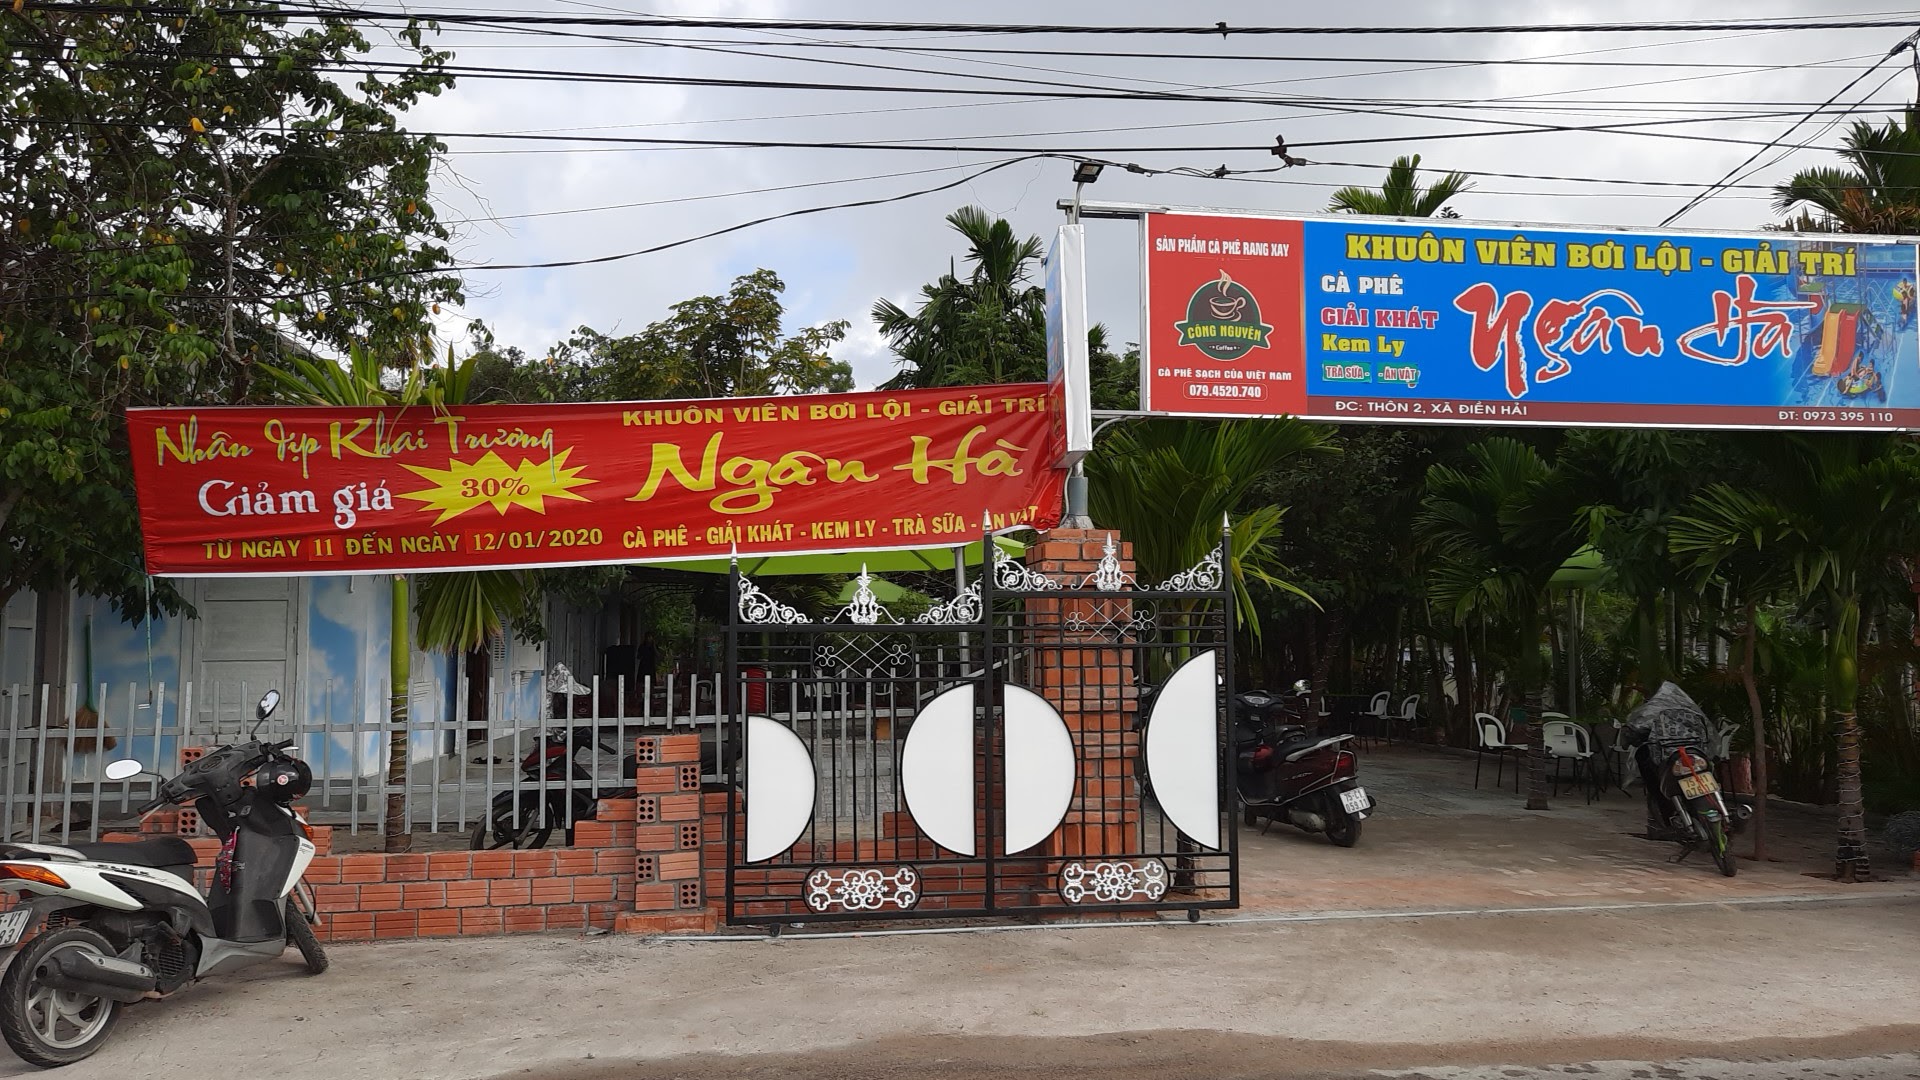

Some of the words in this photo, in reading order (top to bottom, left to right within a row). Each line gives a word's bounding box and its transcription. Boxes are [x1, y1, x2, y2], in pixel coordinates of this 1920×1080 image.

[1156, 235, 1176, 252] SẢN
[1208, 239, 1221, 254] CÀ
[1222, 239, 1241, 255] PHÊ
[1243, 241, 1269, 256] RANG
[1271, 243, 1290, 257] XAY
[1346, 231, 1466, 263] KHUÔN
[1474, 234, 1557, 267] VIÊN
[1567, 240, 1626, 270] BƠI
[1635, 241, 1691, 276] LỘI
[1722, 242, 1790, 275] GIẢI
[1798, 247, 1857, 276] TRÍ
[1321, 271, 1350, 293] CÀ
[1358, 274, 1404, 295] PHÊ
[1321, 302, 1369, 327] GIẢI
[1375, 306, 1439, 329] KHÁT
[1187, 324, 1217, 339] CÔNG
[1322, 333, 1370, 352] Kem
[1378, 335, 1405, 358] Ly
[1158, 366, 1171, 377] CÀ
[1173, 368, 1192, 378] PHÊ
[1195, 369, 1221, 380] SẠCH
[1224, 368, 1243, 379] CỦA
[1246, 370, 1266, 382] VIỆT
[1269, 372, 1292, 381] NAM
[1325, 365, 1344, 379] TRÀ
[1189, 384, 1262, 398] 079.4520.740
[623, 405, 724, 426] KHUÔN
[733, 402, 800, 422] VIÊN
[810, 401, 856, 420] BƠI
[867, 398, 911, 421] LỘI
[938, 394, 992, 416] GIẢI
[1001, 393, 1046, 413] TRÍ
[1335, 401, 1363, 412] ĐC:
[1367, 400, 1409, 413] THÔN
[1413, 403, 1426, 415] 2,
[1430, 402, 1453, 414] XÃ
[1459, 401, 1497, 415] ĐIỀN
[1501, 402, 1528, 416] HẢI
[1778, 411, 1799, 420] ĐT:
[1803, 411, 1836, 421] 0973
[1840, 412, 1864, 421] 395
[1869, 412, 1893, 422] 110
[155, 414, 253, 467] Nhân
[329, 410, 428, 460] Khai
[625, 431, 879, 515] Ngân
[893, 425, 1029, 485] Hà
[461, 476, 531, 499] 30%
[198, 479, 320, 517] Giảm
[333, 479, 394, 529] giá
[623, 526, 647, 549] CÀ
[653, 525, 689, 547] PHÊ
[706, 519, 742, 545] GIẢI
[747, 519, 794, 543] KHÁT
[811, 521, 850, 540] KEM
[855, 519, 876, 538] LY
[892, 513, 927, 536] TRÀ
[932, 512, 966, 534] SỮA
[242, 536, 301, 559] NGÀY
[313, 538, 334, 557] 11
[345, 531, 394, 556] ĐẾN
[401, 531, 460, 554] NGÀY
[473, 528, 604, 551] 12/01/2020
